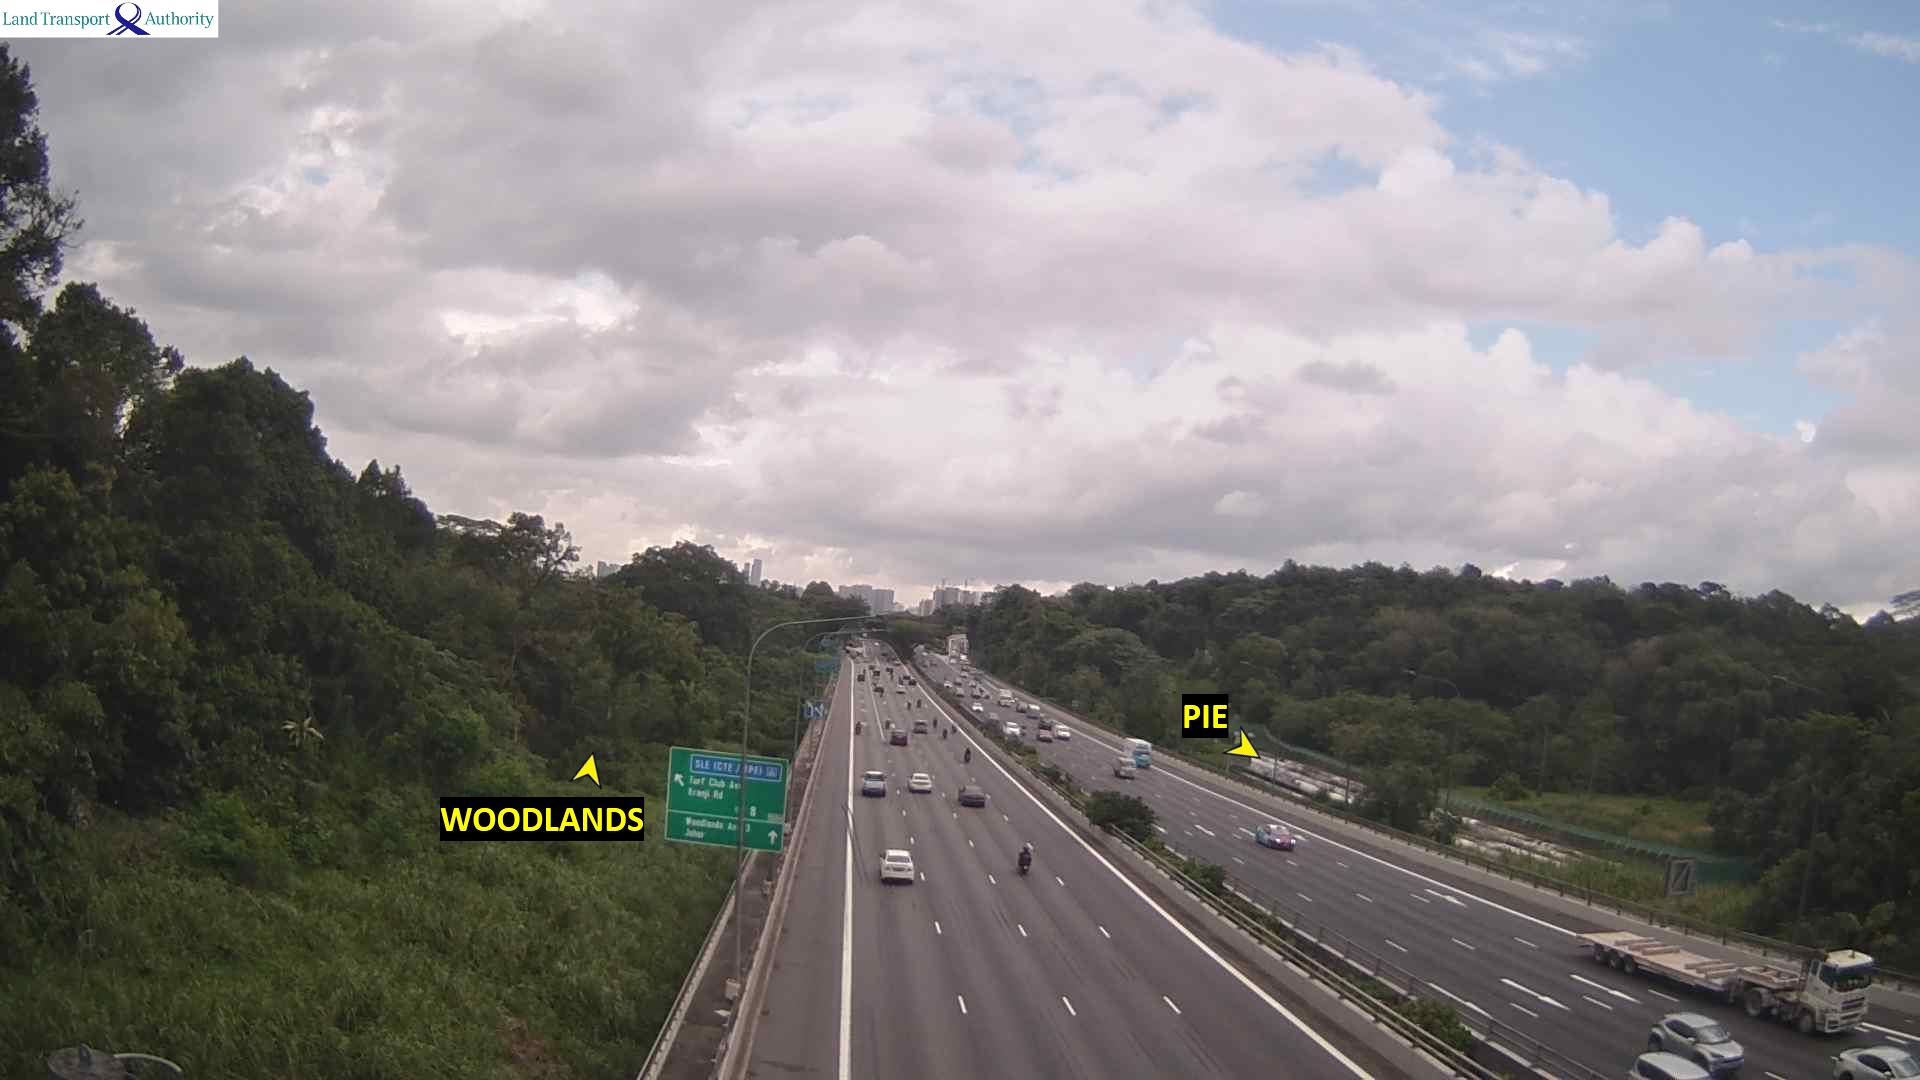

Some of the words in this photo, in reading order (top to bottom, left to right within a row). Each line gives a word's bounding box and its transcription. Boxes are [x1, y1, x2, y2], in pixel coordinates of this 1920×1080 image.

[689, 775, 706, 785] Turf
[709, 777, 726, 788] Club
[713, 790, 723, 800] Rd
